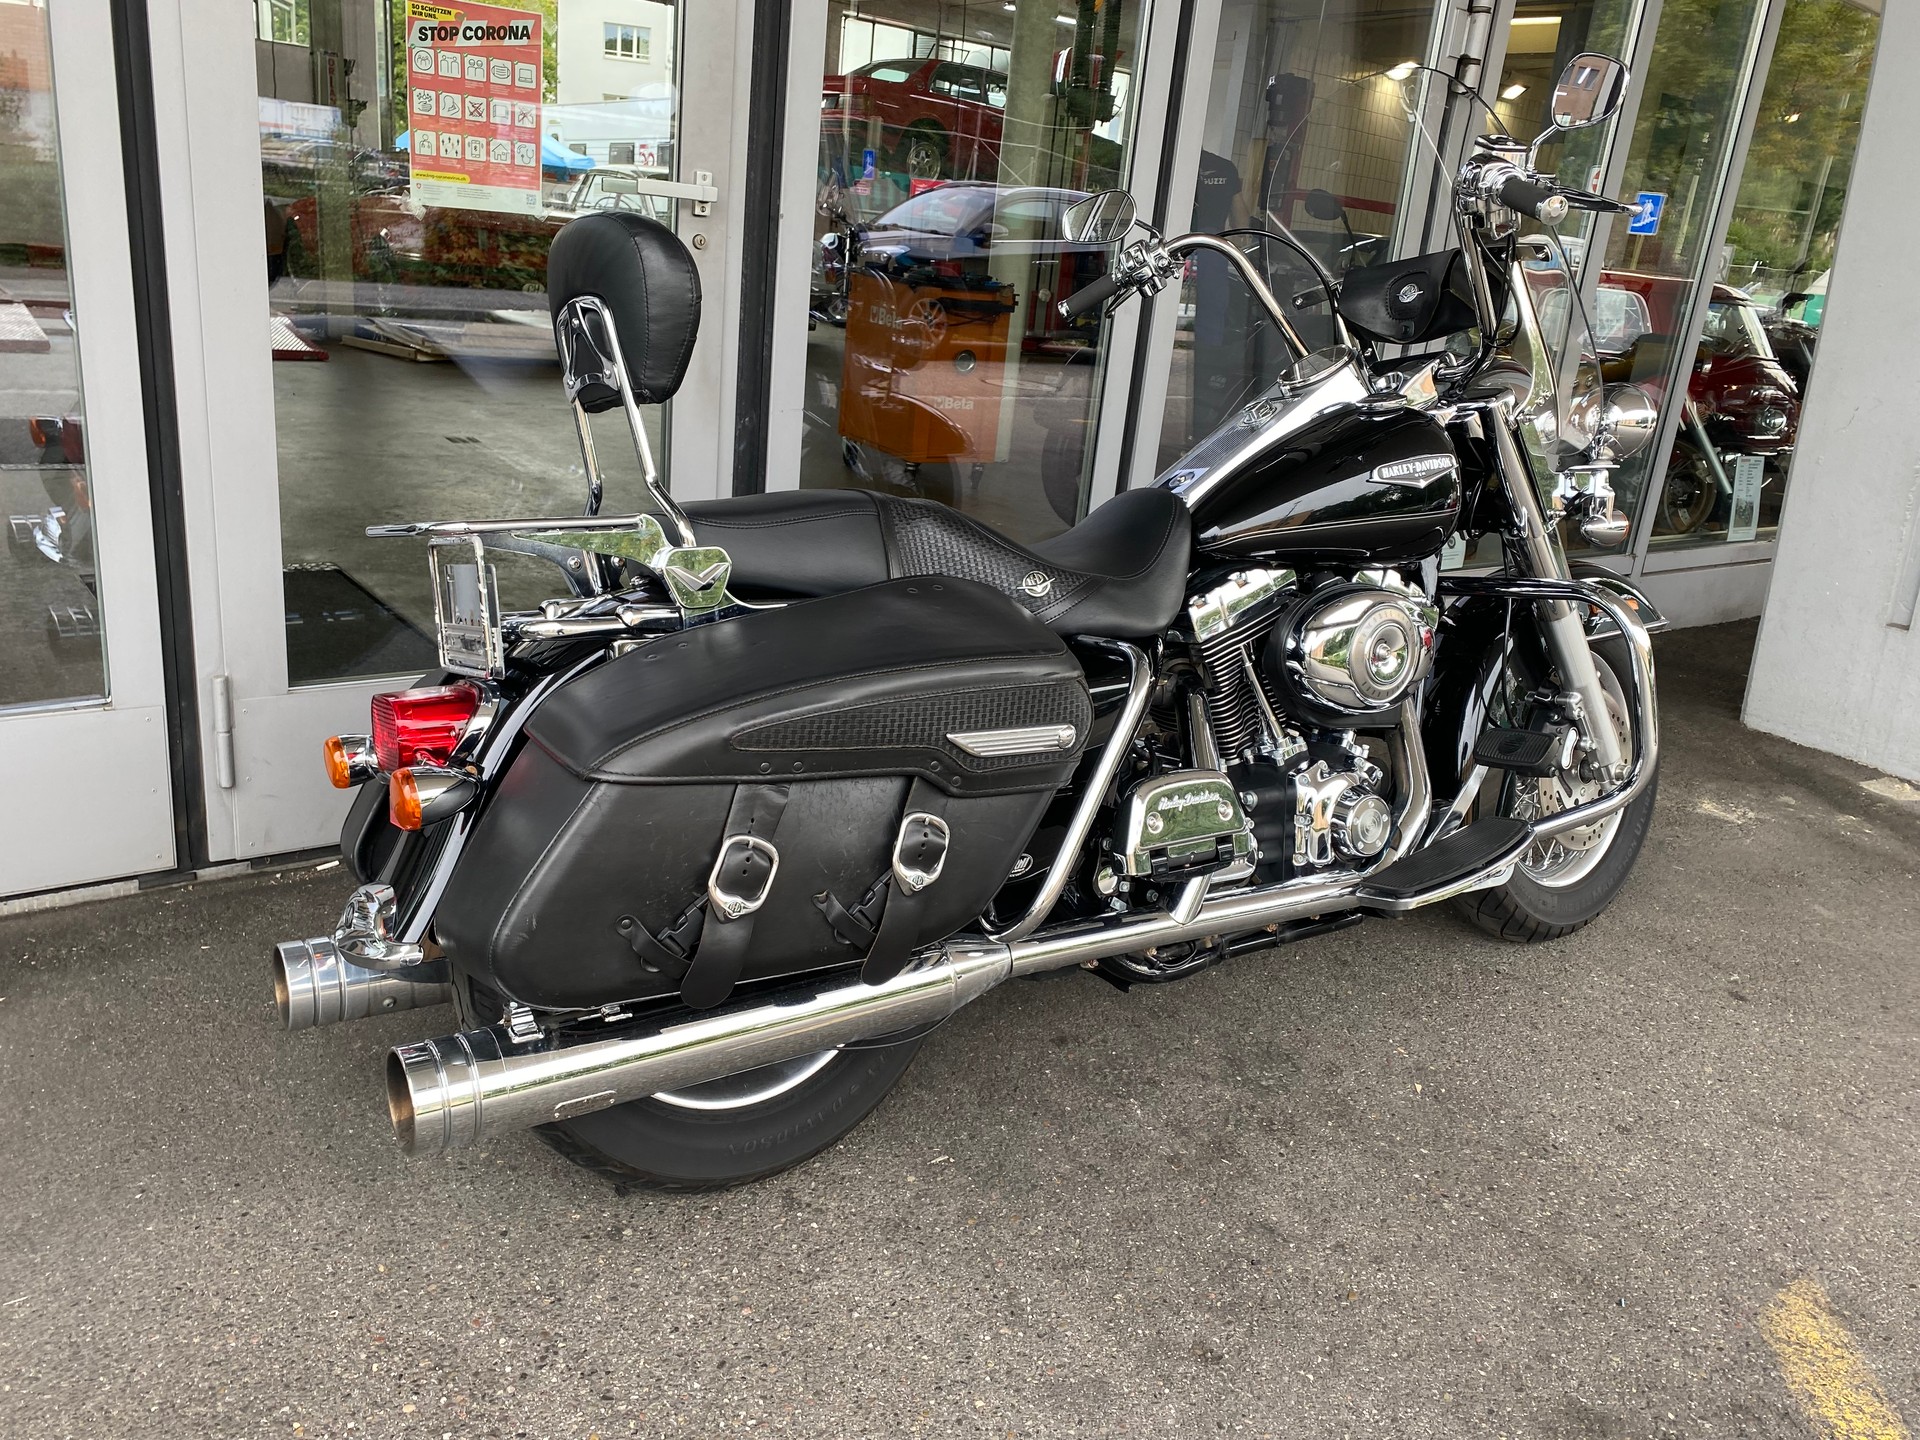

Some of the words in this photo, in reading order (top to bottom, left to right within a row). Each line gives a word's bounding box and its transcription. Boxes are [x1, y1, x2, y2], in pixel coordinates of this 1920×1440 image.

[420, 5, 452, 16] SCHÜTZEN
[423, 12, 439, 20] UNS.
[418, 25, 460, 42] STOP
[462, 25, 531, 41] CORONA
[944, 398, 974, 411] Beta
[1382, 457, 1452, 478] HARLEY-DAVIDSON
